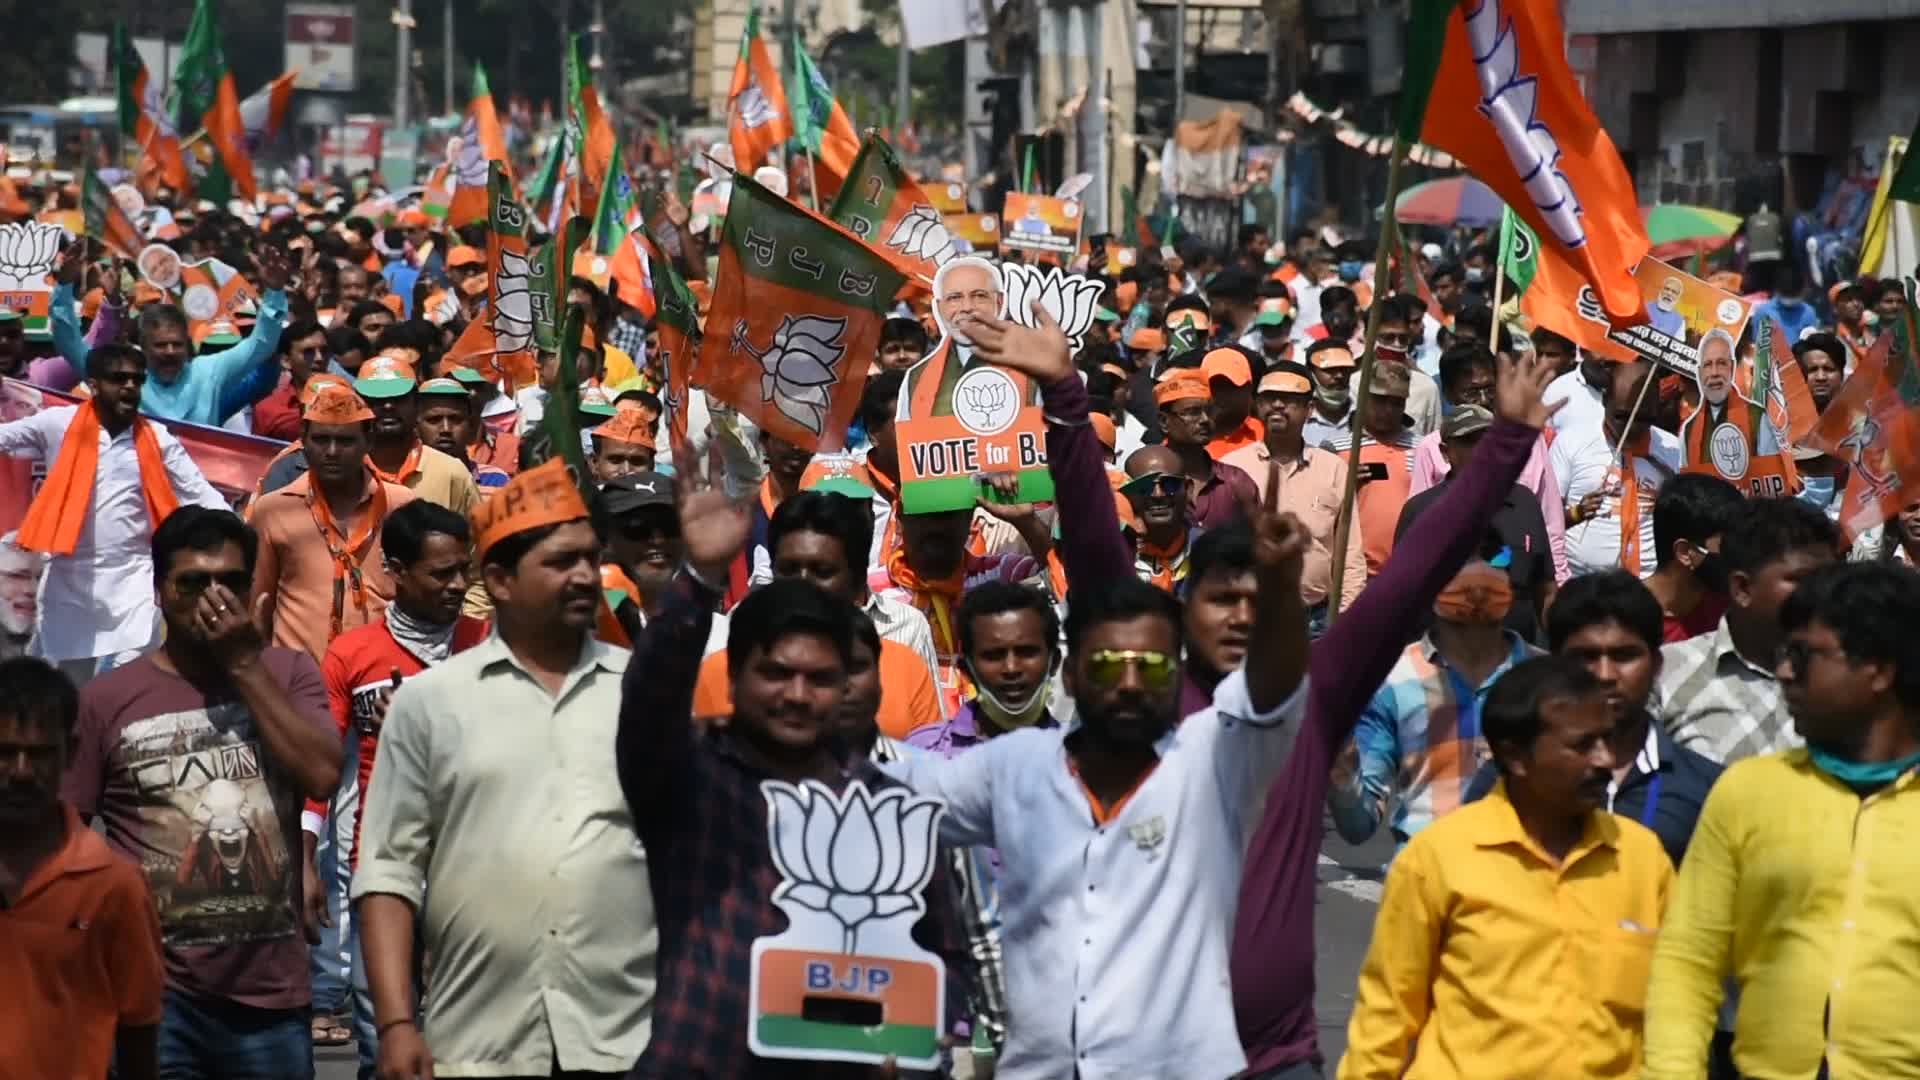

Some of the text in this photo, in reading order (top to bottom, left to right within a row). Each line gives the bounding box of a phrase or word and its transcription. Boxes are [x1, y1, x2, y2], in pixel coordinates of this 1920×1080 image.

[909, 431, 1051, 478] VOTE for BJ
[806, 961, 891, 993] BJP
